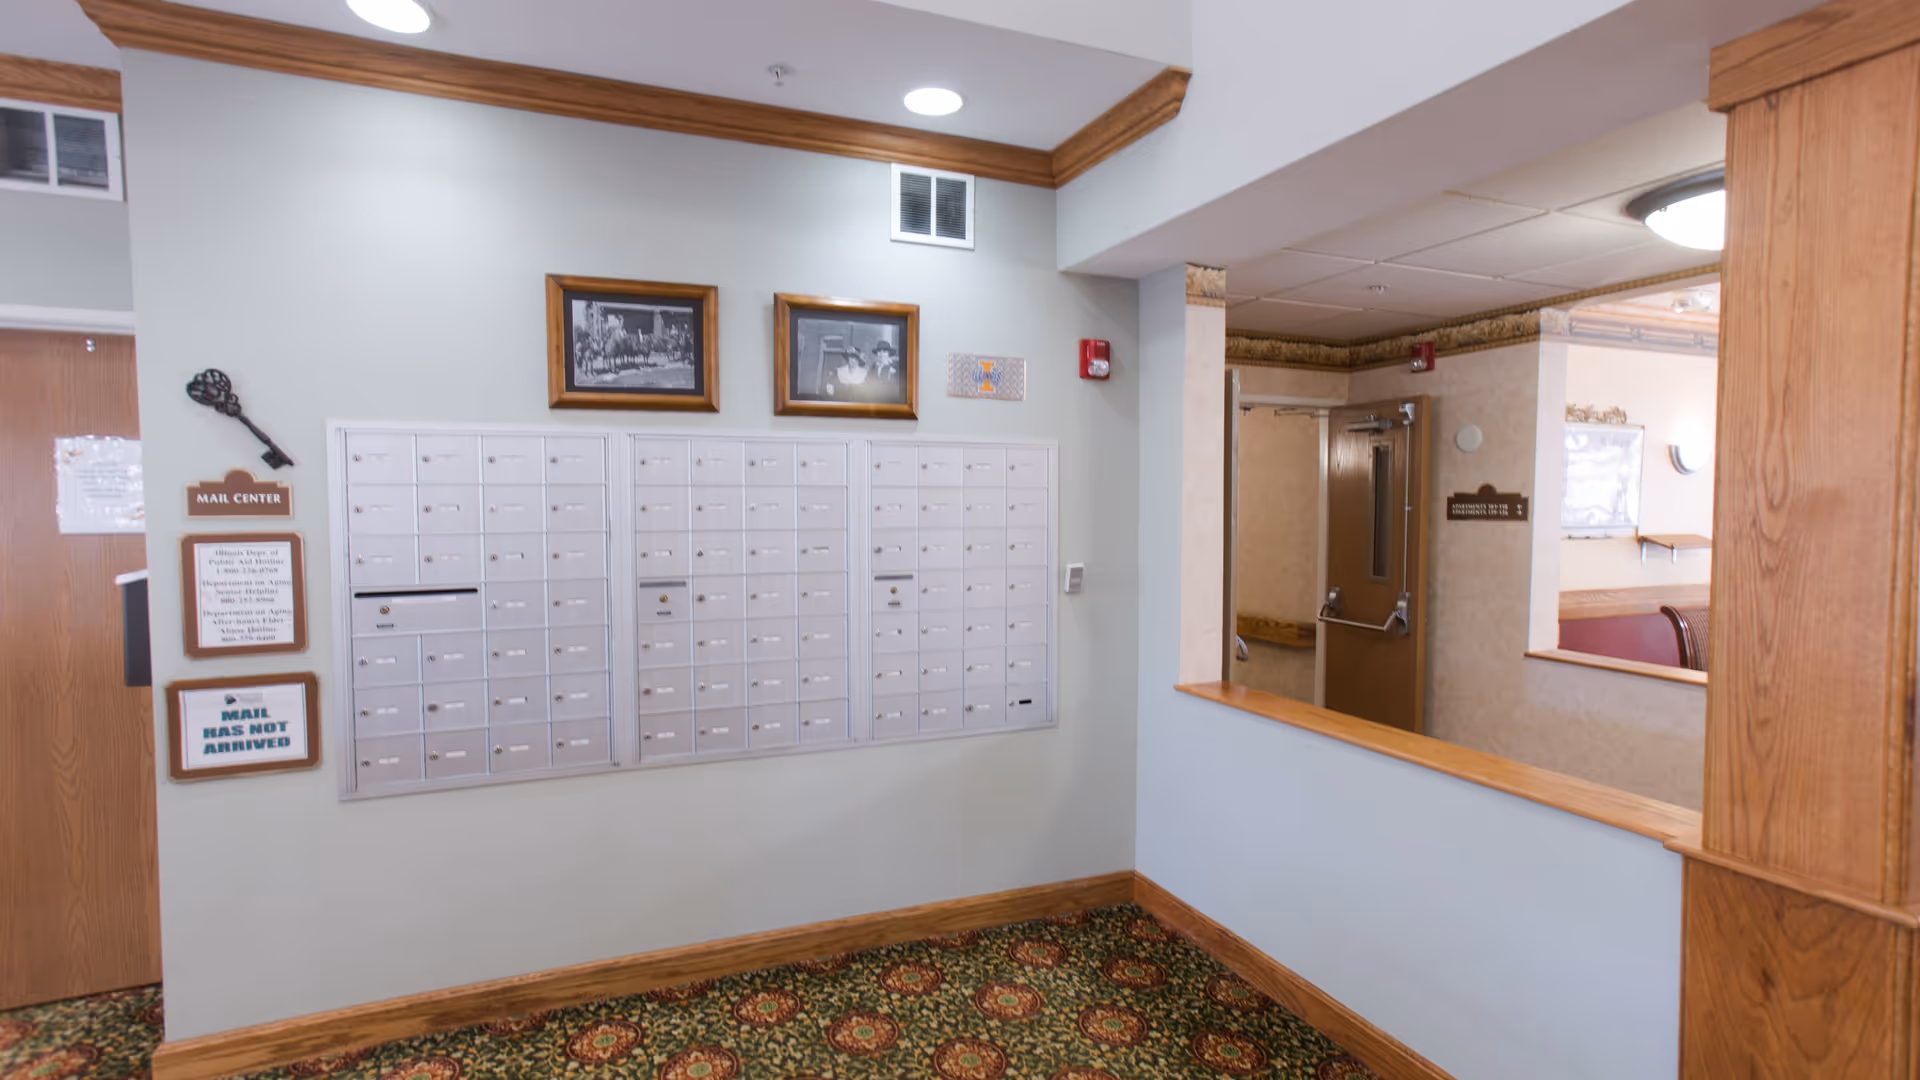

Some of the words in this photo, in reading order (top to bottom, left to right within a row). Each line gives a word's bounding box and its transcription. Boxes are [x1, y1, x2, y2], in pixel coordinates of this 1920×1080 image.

[197, 493, 229, 504] MAIL
[233, 493, 281, 504] CENTER
[202, 579, 252, 587] Department
[245, 588, 278, 596] Helpline
[203, 609, 253, 617] Department
[221, 708, 270, 721] MAIL
[203, 725, 244, 739] HAS
[249, 721, 289, 734] NOT
[203, 737, 290, 754] ARRIVED
